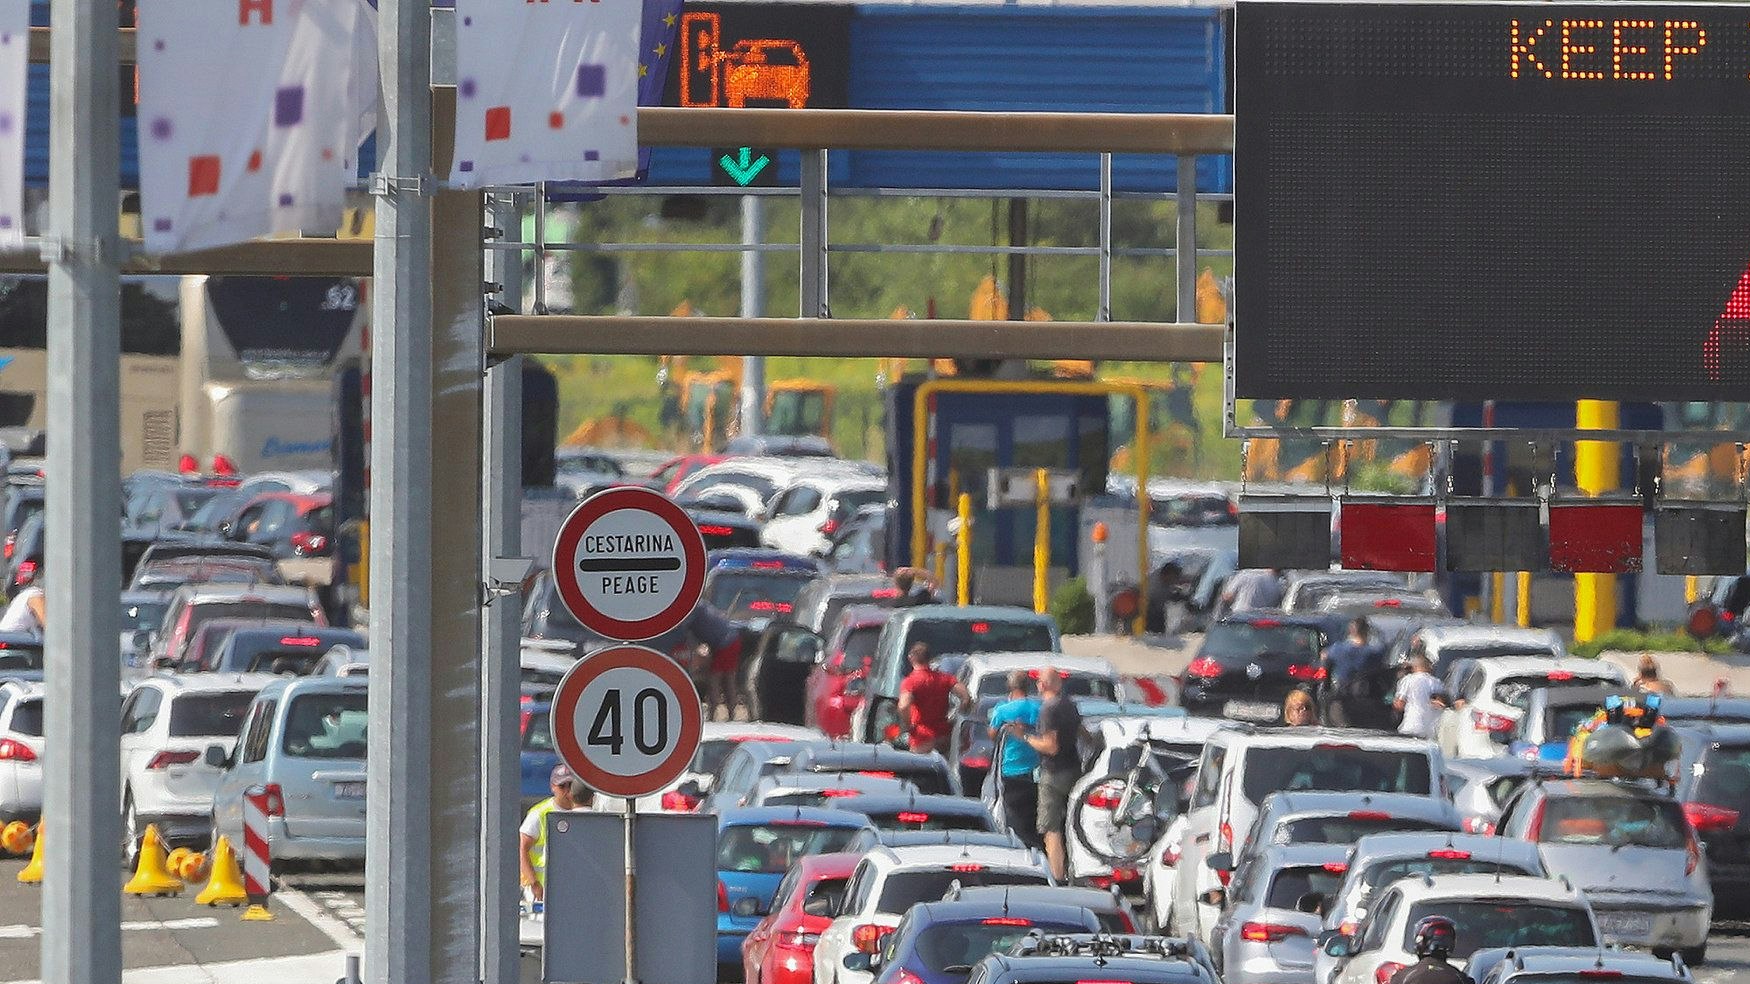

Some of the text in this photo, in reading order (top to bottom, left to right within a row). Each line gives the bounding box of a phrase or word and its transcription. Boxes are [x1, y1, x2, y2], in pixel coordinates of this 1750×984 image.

[1510, 19, 1706, 79] KEEP
[585, 534, 674, 553] CESTARINA
[602, 575, 659, 595] PEAGE
[587, 687, 668, 756] 40
